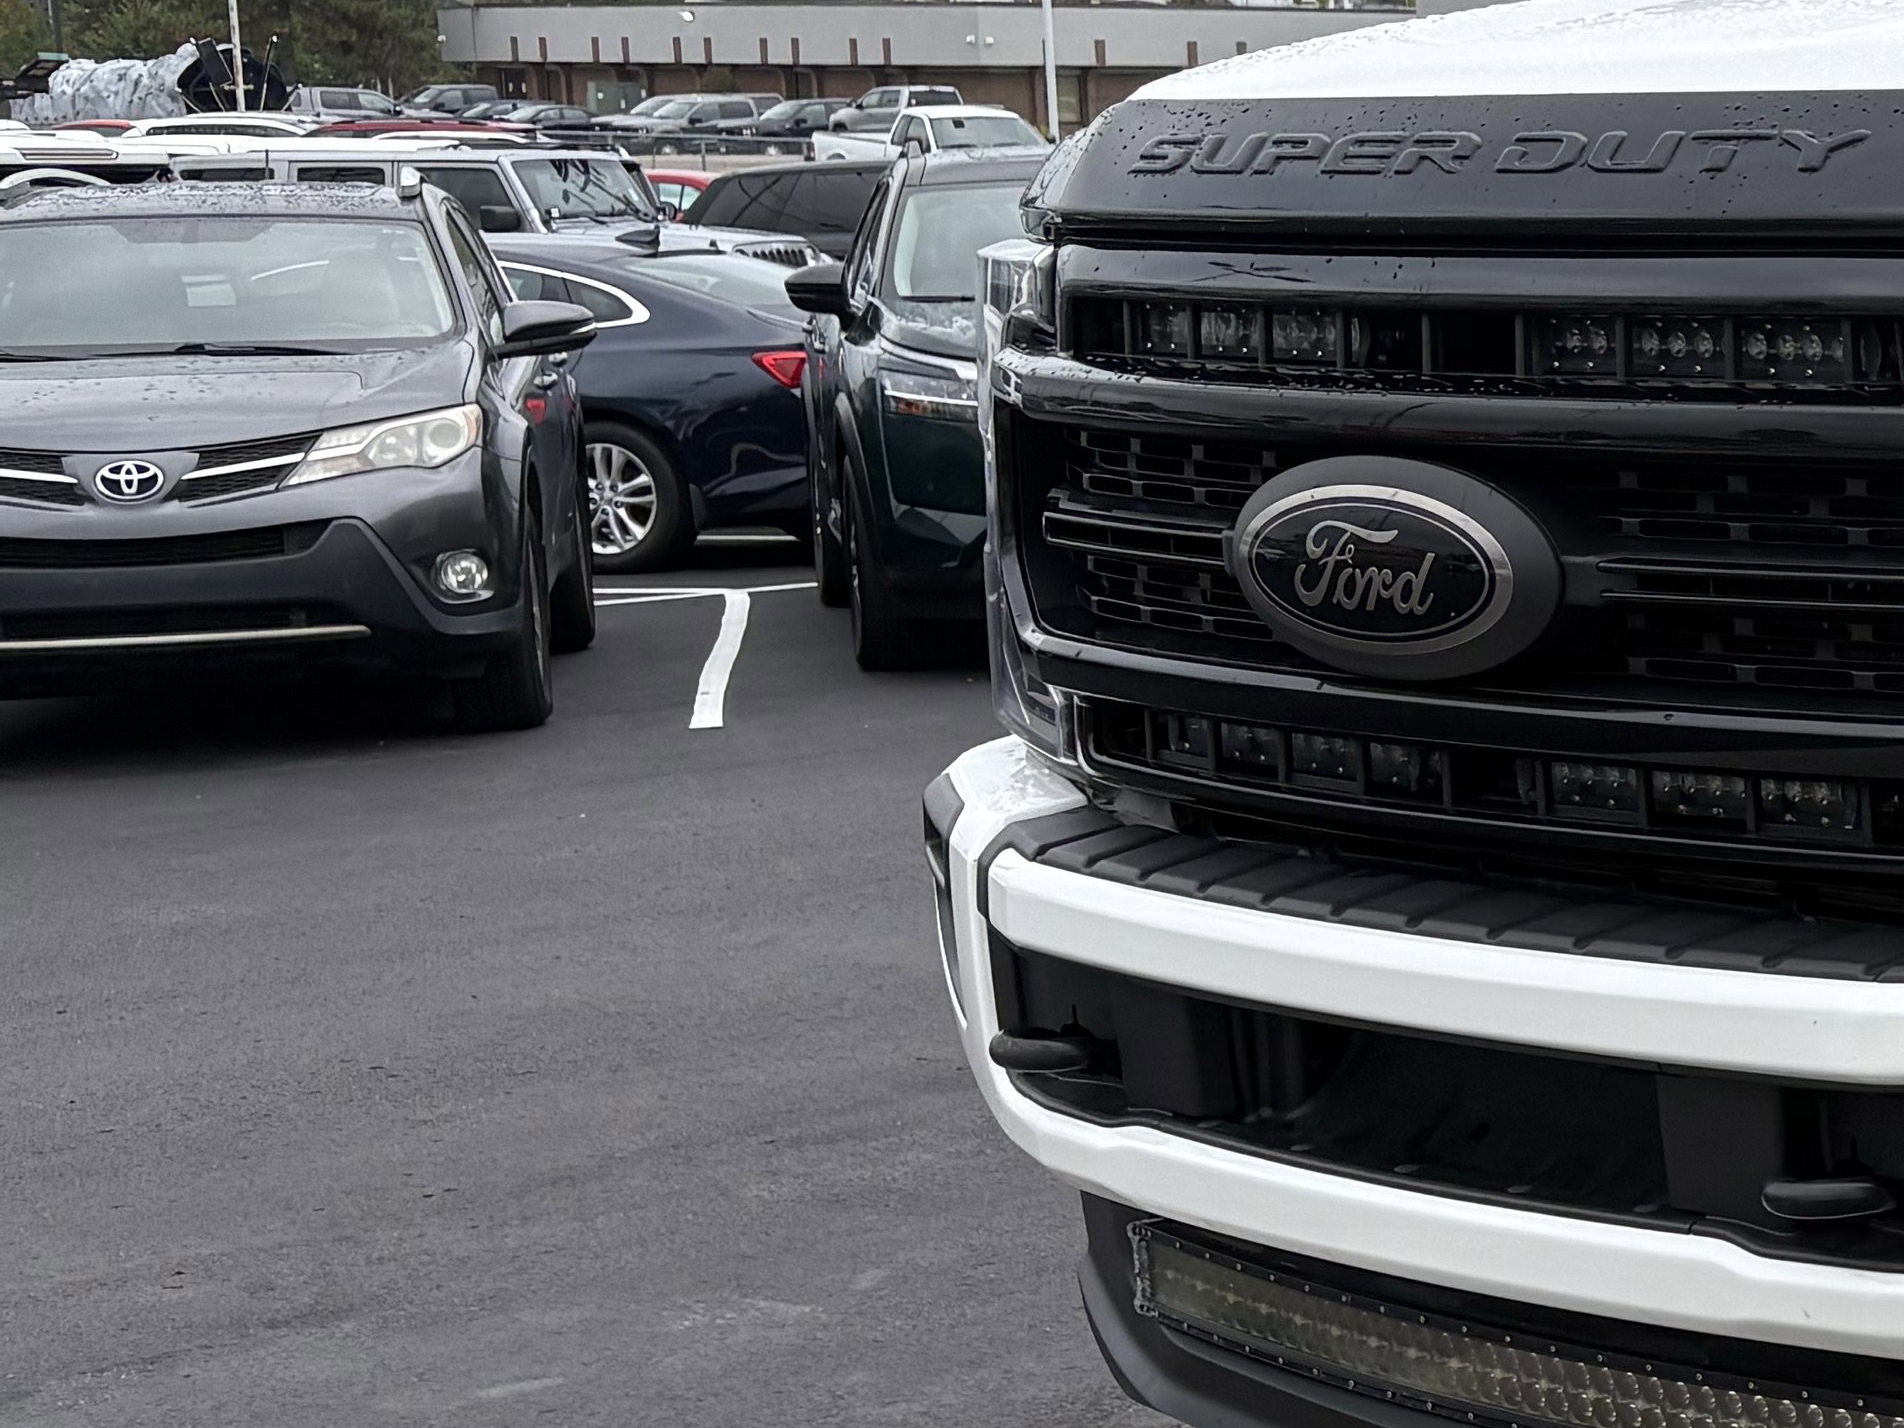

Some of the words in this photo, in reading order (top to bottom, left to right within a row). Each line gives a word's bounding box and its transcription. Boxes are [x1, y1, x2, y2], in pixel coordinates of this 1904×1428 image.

[1128, 131, 1482, 175] SUPER
[1495, 129, 1872, 174] DUTY
[1294, 520, 1436, 616] Ford
